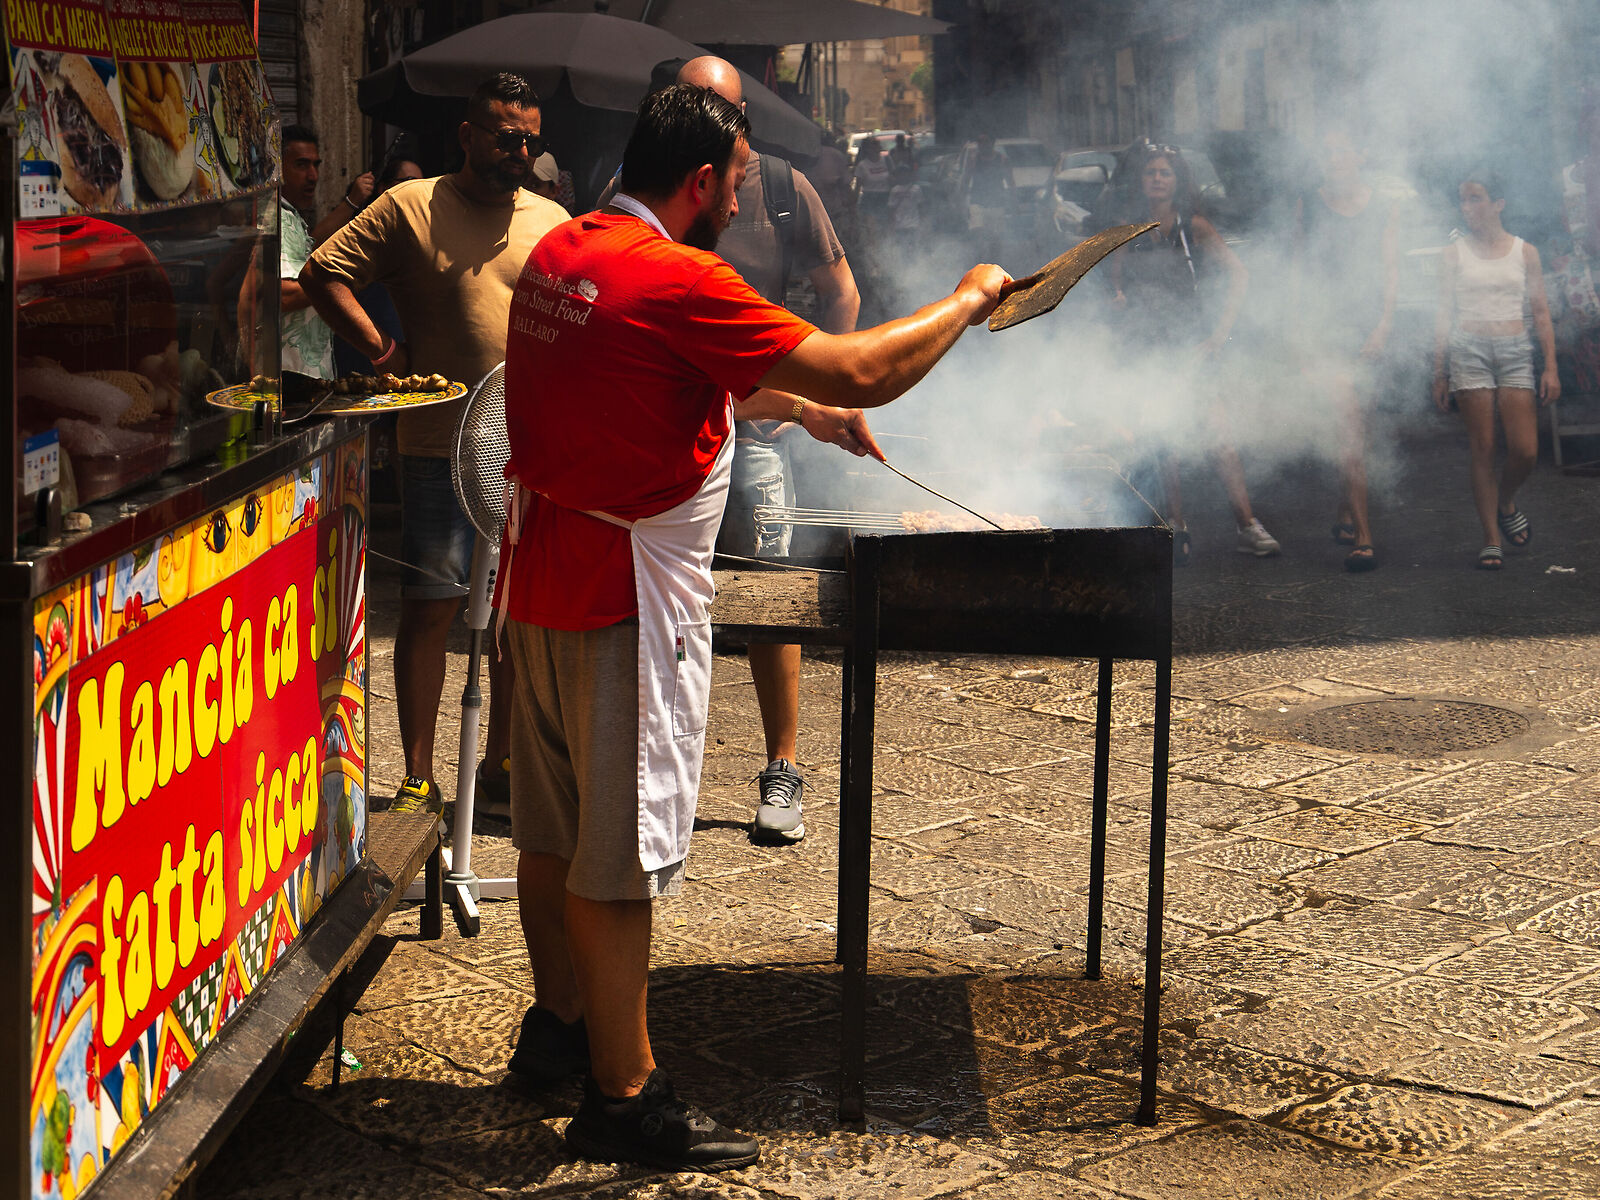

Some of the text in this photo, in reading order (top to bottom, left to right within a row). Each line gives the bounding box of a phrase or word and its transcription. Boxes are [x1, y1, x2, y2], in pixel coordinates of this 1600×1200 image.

[65, 6, 111, 52] MEUSA
[529, 289, 555, 316] Street
[554, 298, 593, 326] Food
[553, 276, 576, 296] Pace
[71, 543, 339, 854] Mancia ca si
[100, 734, 320, 1048] fatta sicca
